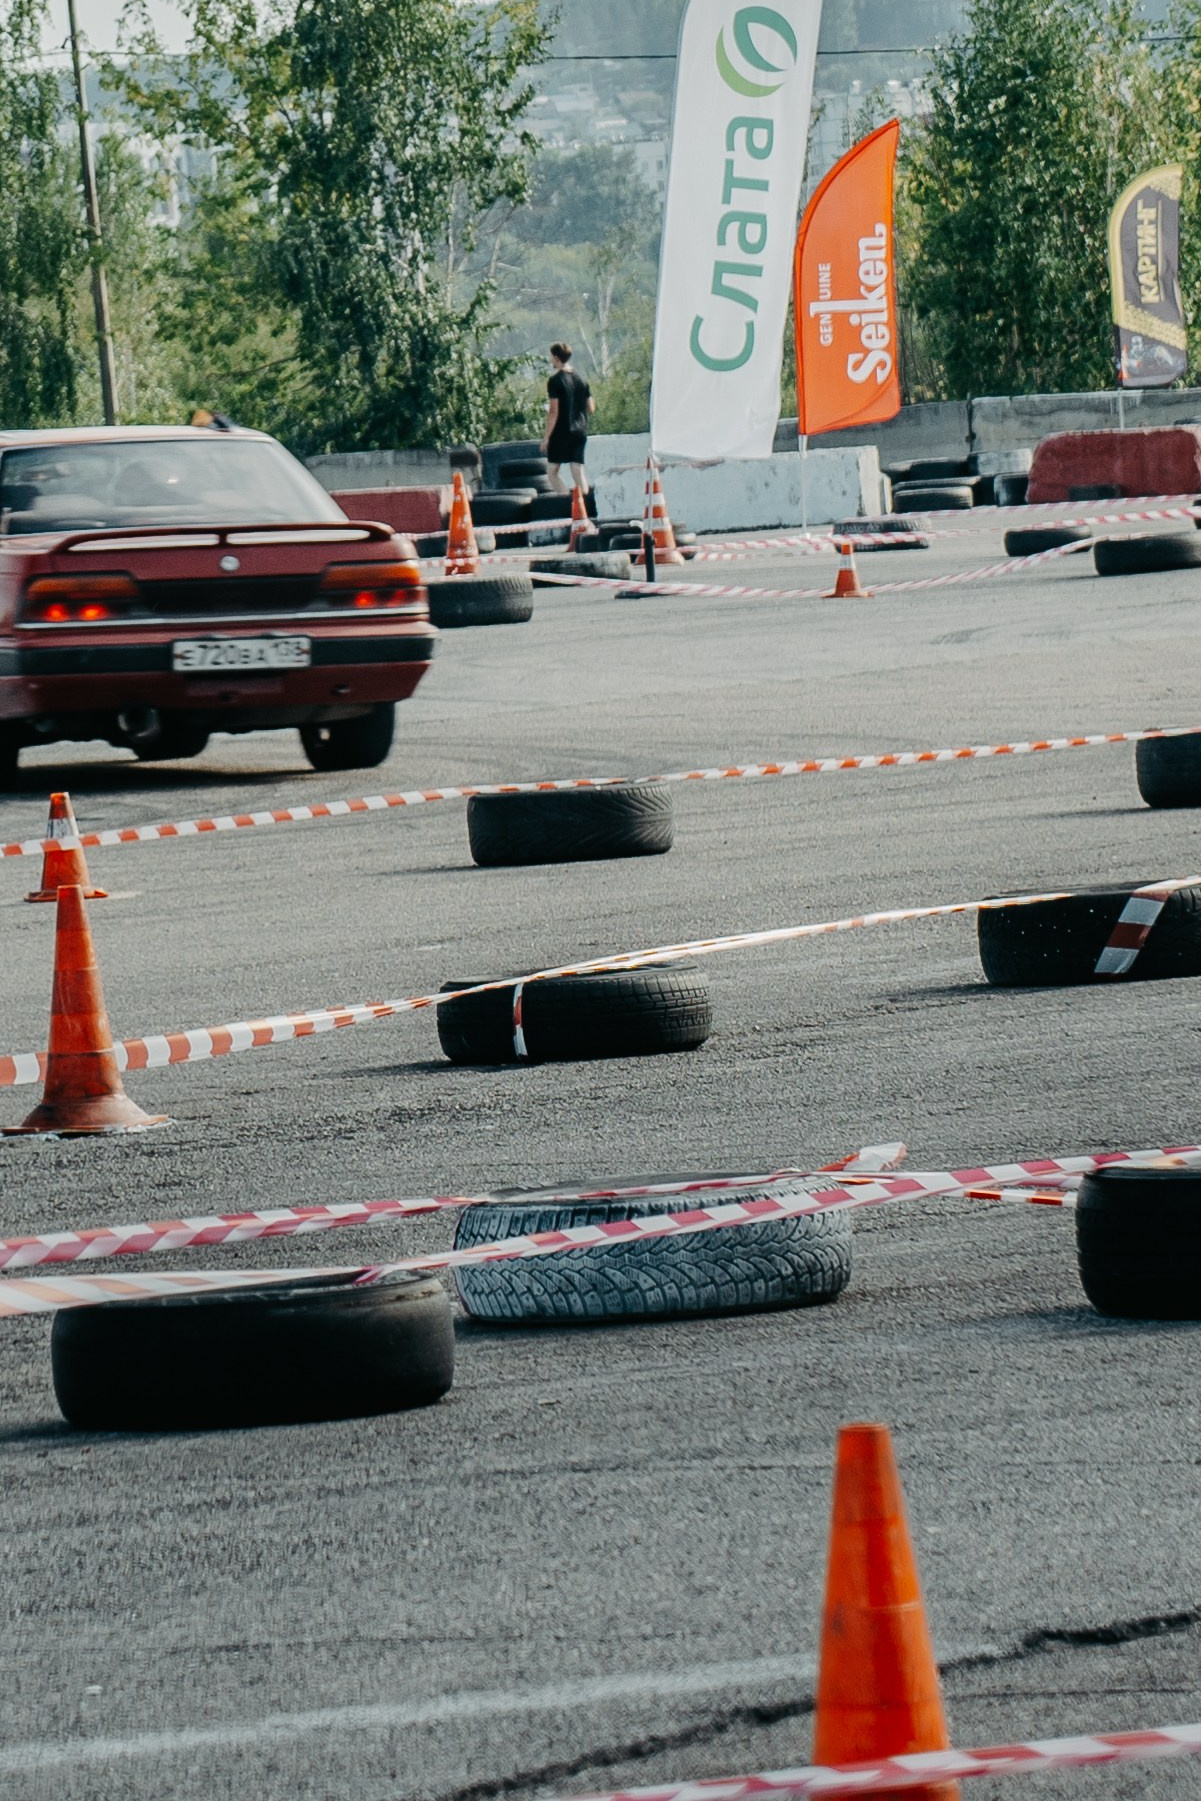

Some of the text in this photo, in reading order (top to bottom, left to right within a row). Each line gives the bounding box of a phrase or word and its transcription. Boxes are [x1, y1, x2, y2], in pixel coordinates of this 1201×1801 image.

[689, 115, 774, 371] Слата
[809, 222, 892, 385] Seiken
[1136, 200, 1160, 304] КАРТИНГ
